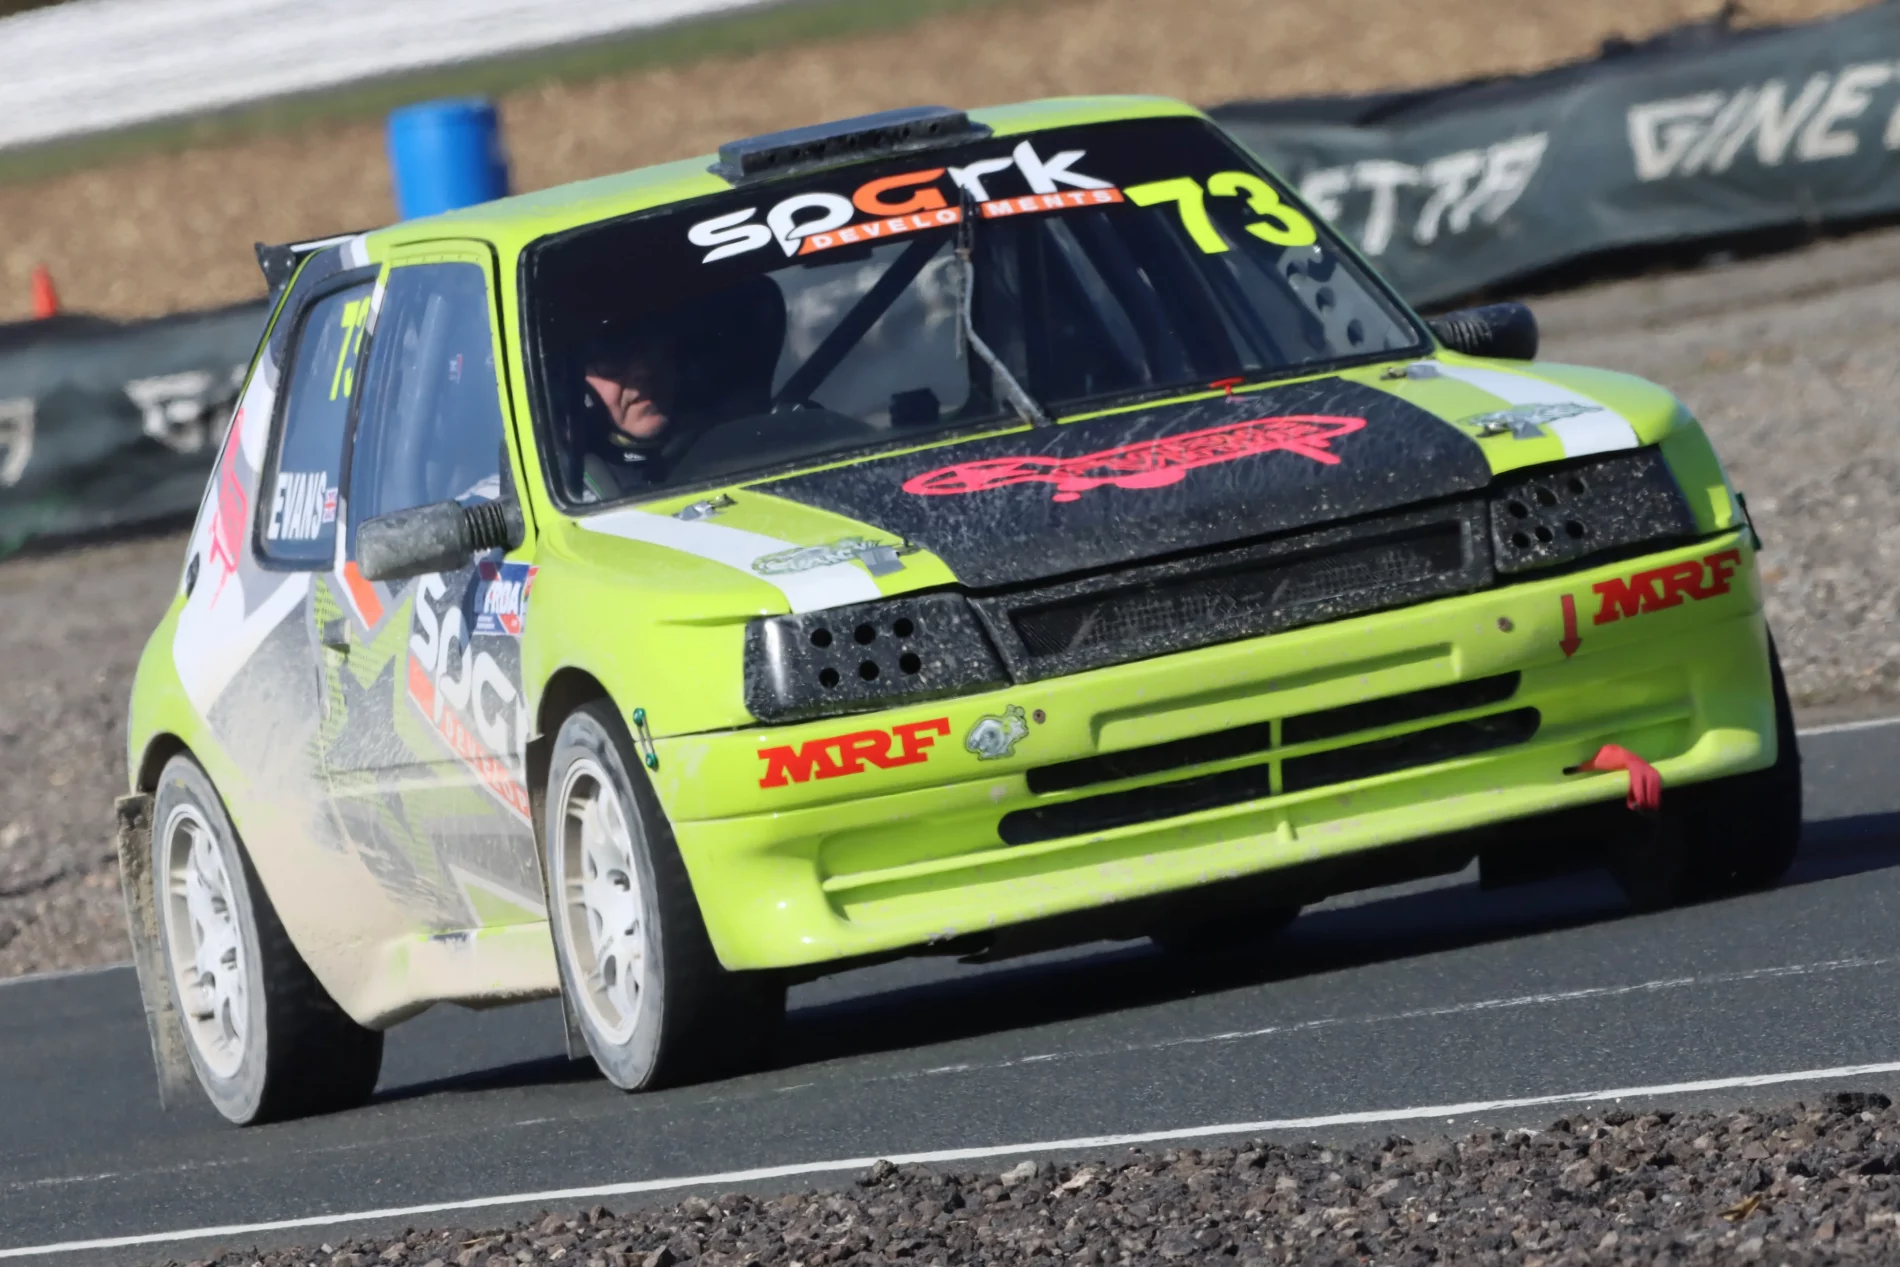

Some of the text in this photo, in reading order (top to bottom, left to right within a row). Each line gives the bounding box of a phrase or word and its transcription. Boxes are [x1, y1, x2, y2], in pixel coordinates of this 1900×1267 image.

[1627, 62, 1900, 182] GINE
[811, 191, 1112, 249] DEVELOMENTS
[1123, 171, 1317, 254] 73
[267, 471, 327, 540] EVANS
[1593, 548, 1741, 625] MRF
[757, 717, 950, 789] MRF
